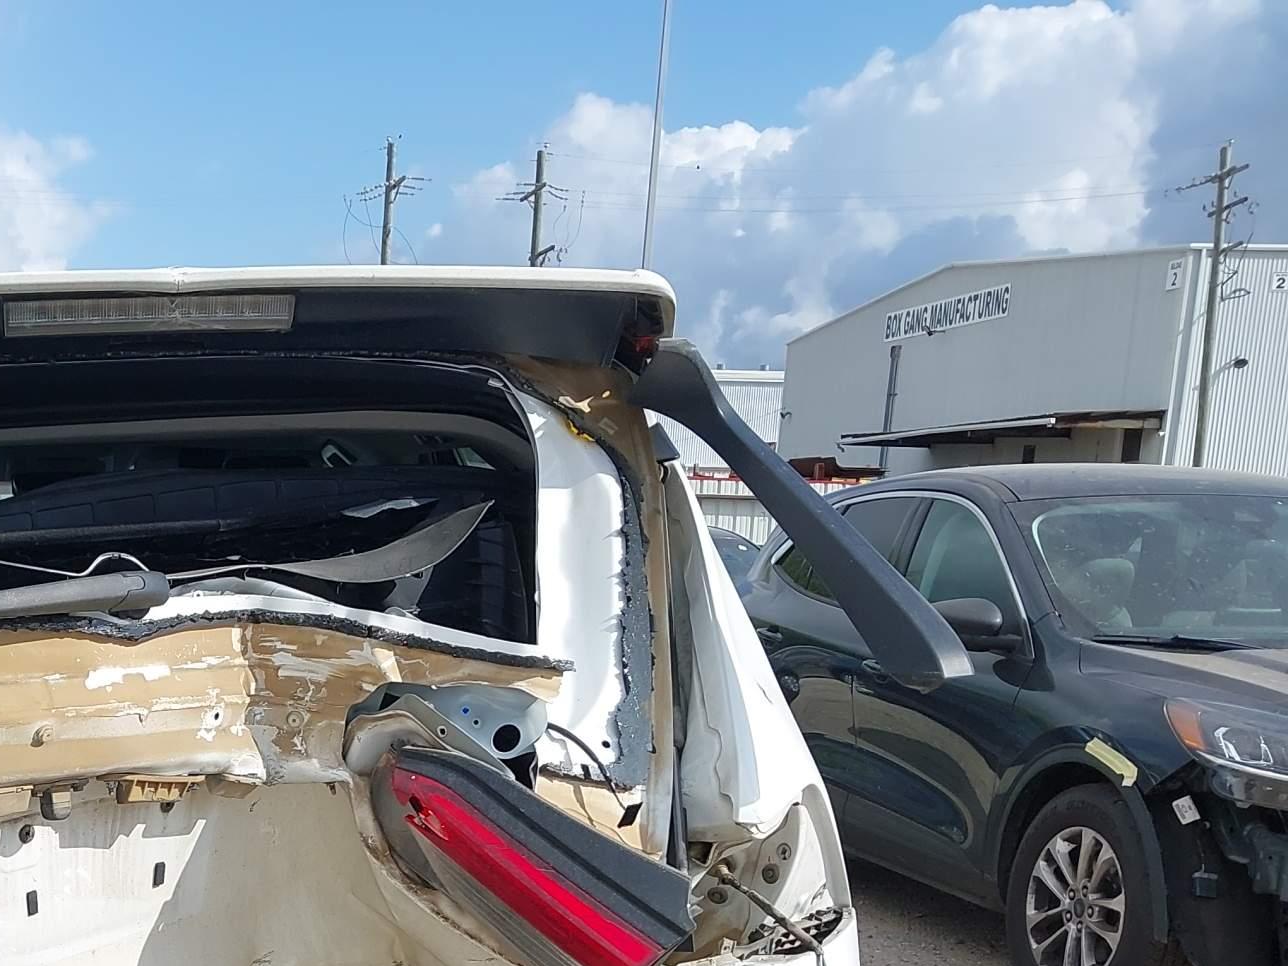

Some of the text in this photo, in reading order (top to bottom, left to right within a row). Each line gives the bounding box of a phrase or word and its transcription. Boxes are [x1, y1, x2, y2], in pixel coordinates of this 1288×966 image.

[1171, 272, 1178, 287] 2
[1275, 277, 1286, 289] 2
[885, 286, 1010, 340] BOX GANG MANUFACTURING
